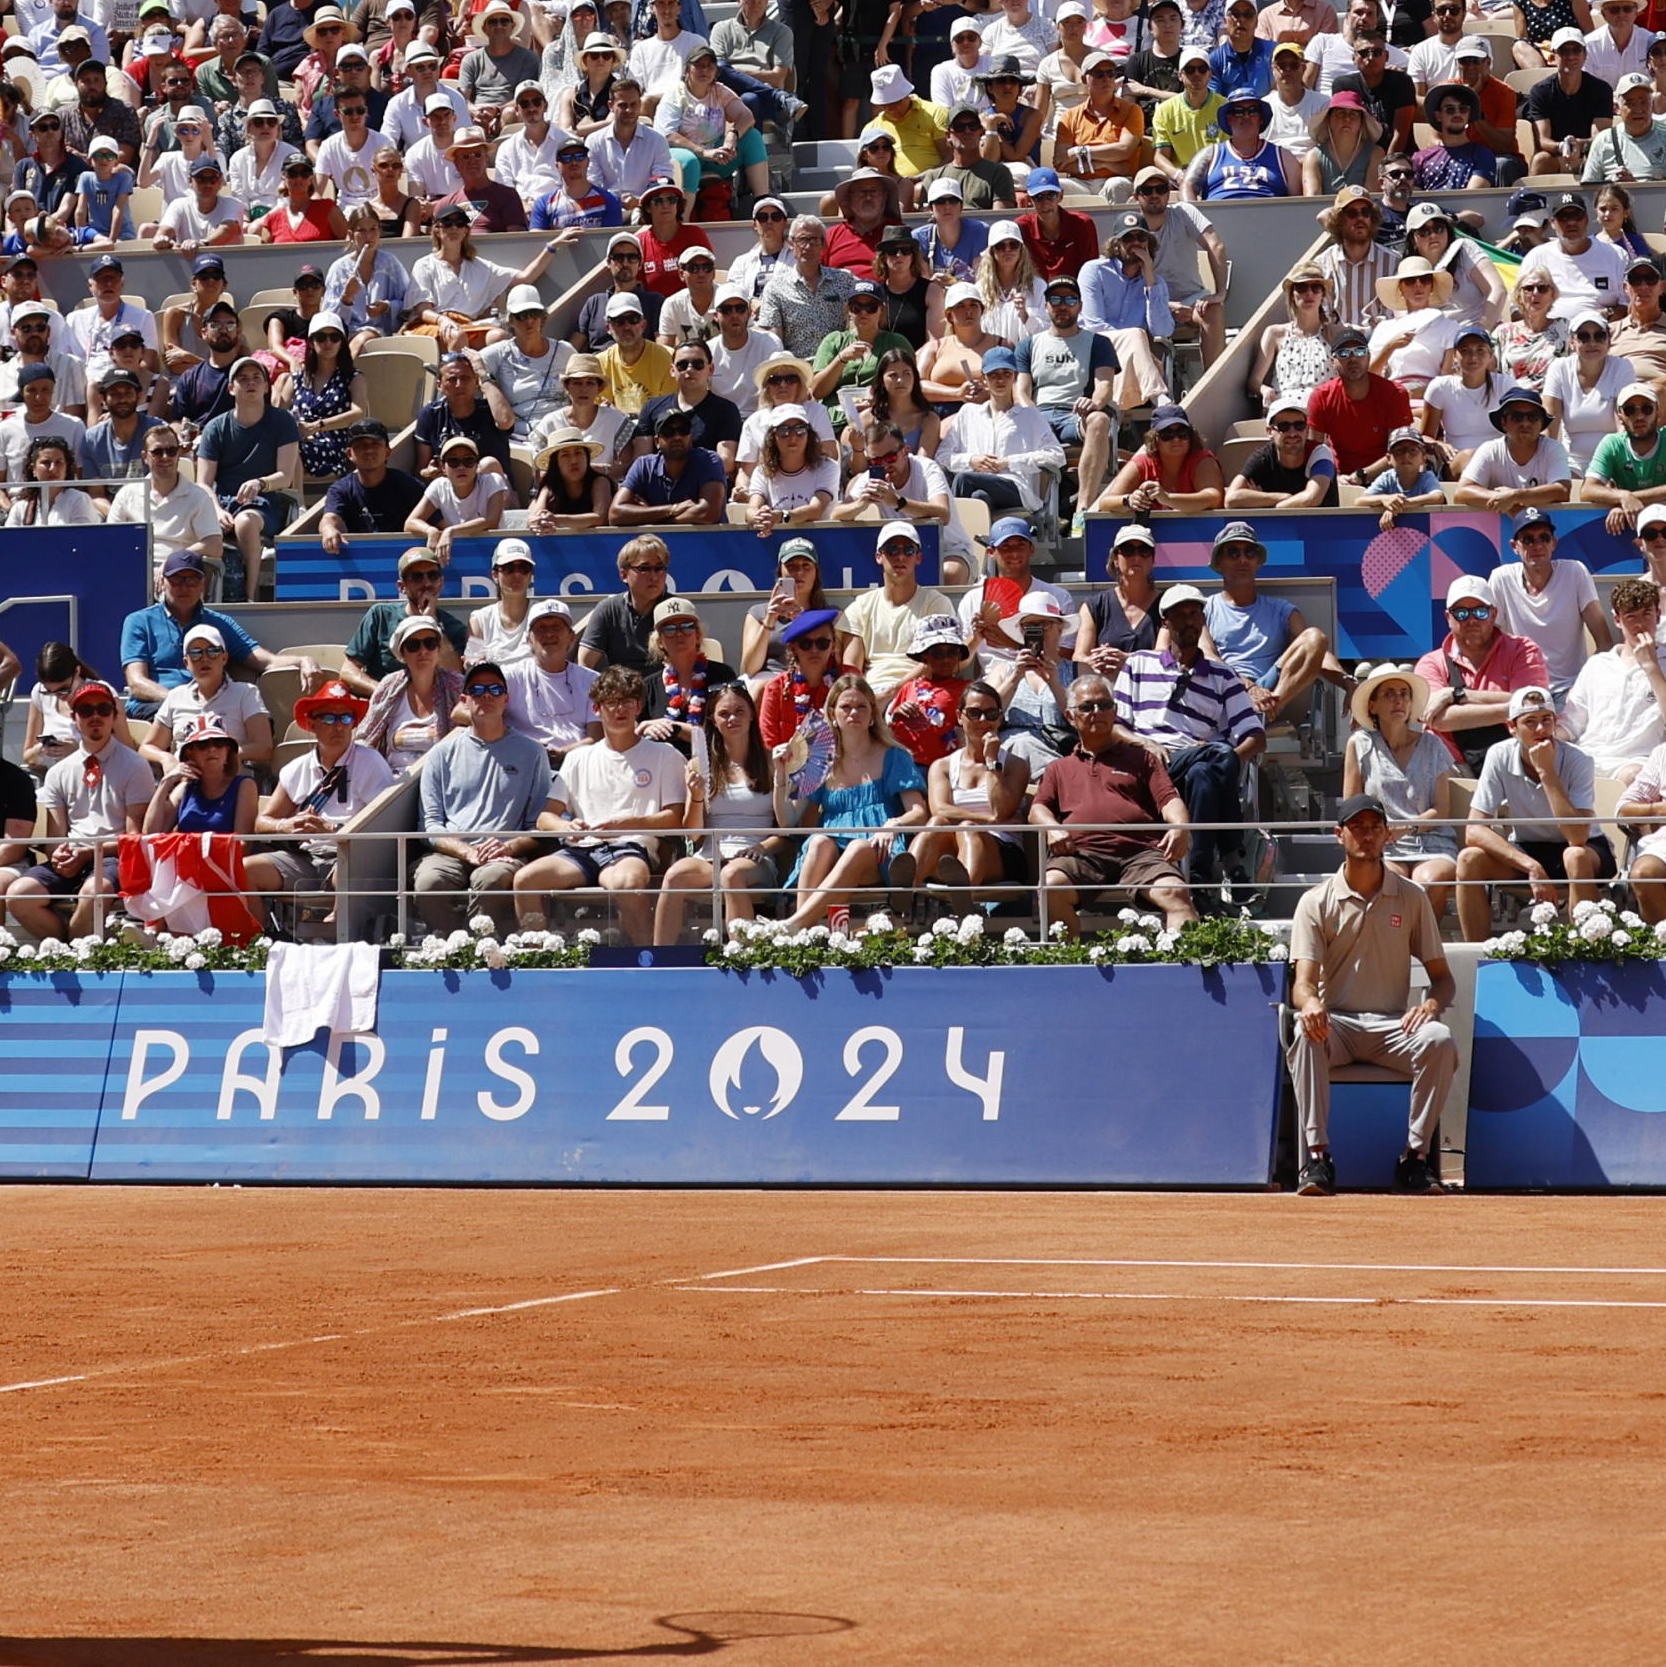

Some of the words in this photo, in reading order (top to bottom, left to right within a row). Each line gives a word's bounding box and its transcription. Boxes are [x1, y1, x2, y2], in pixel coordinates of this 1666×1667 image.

[1221, 165, 1270, 182] USA
[1046, 352, 1077, 364] SUN
[605, 1025, 1006, 1121] 2024
